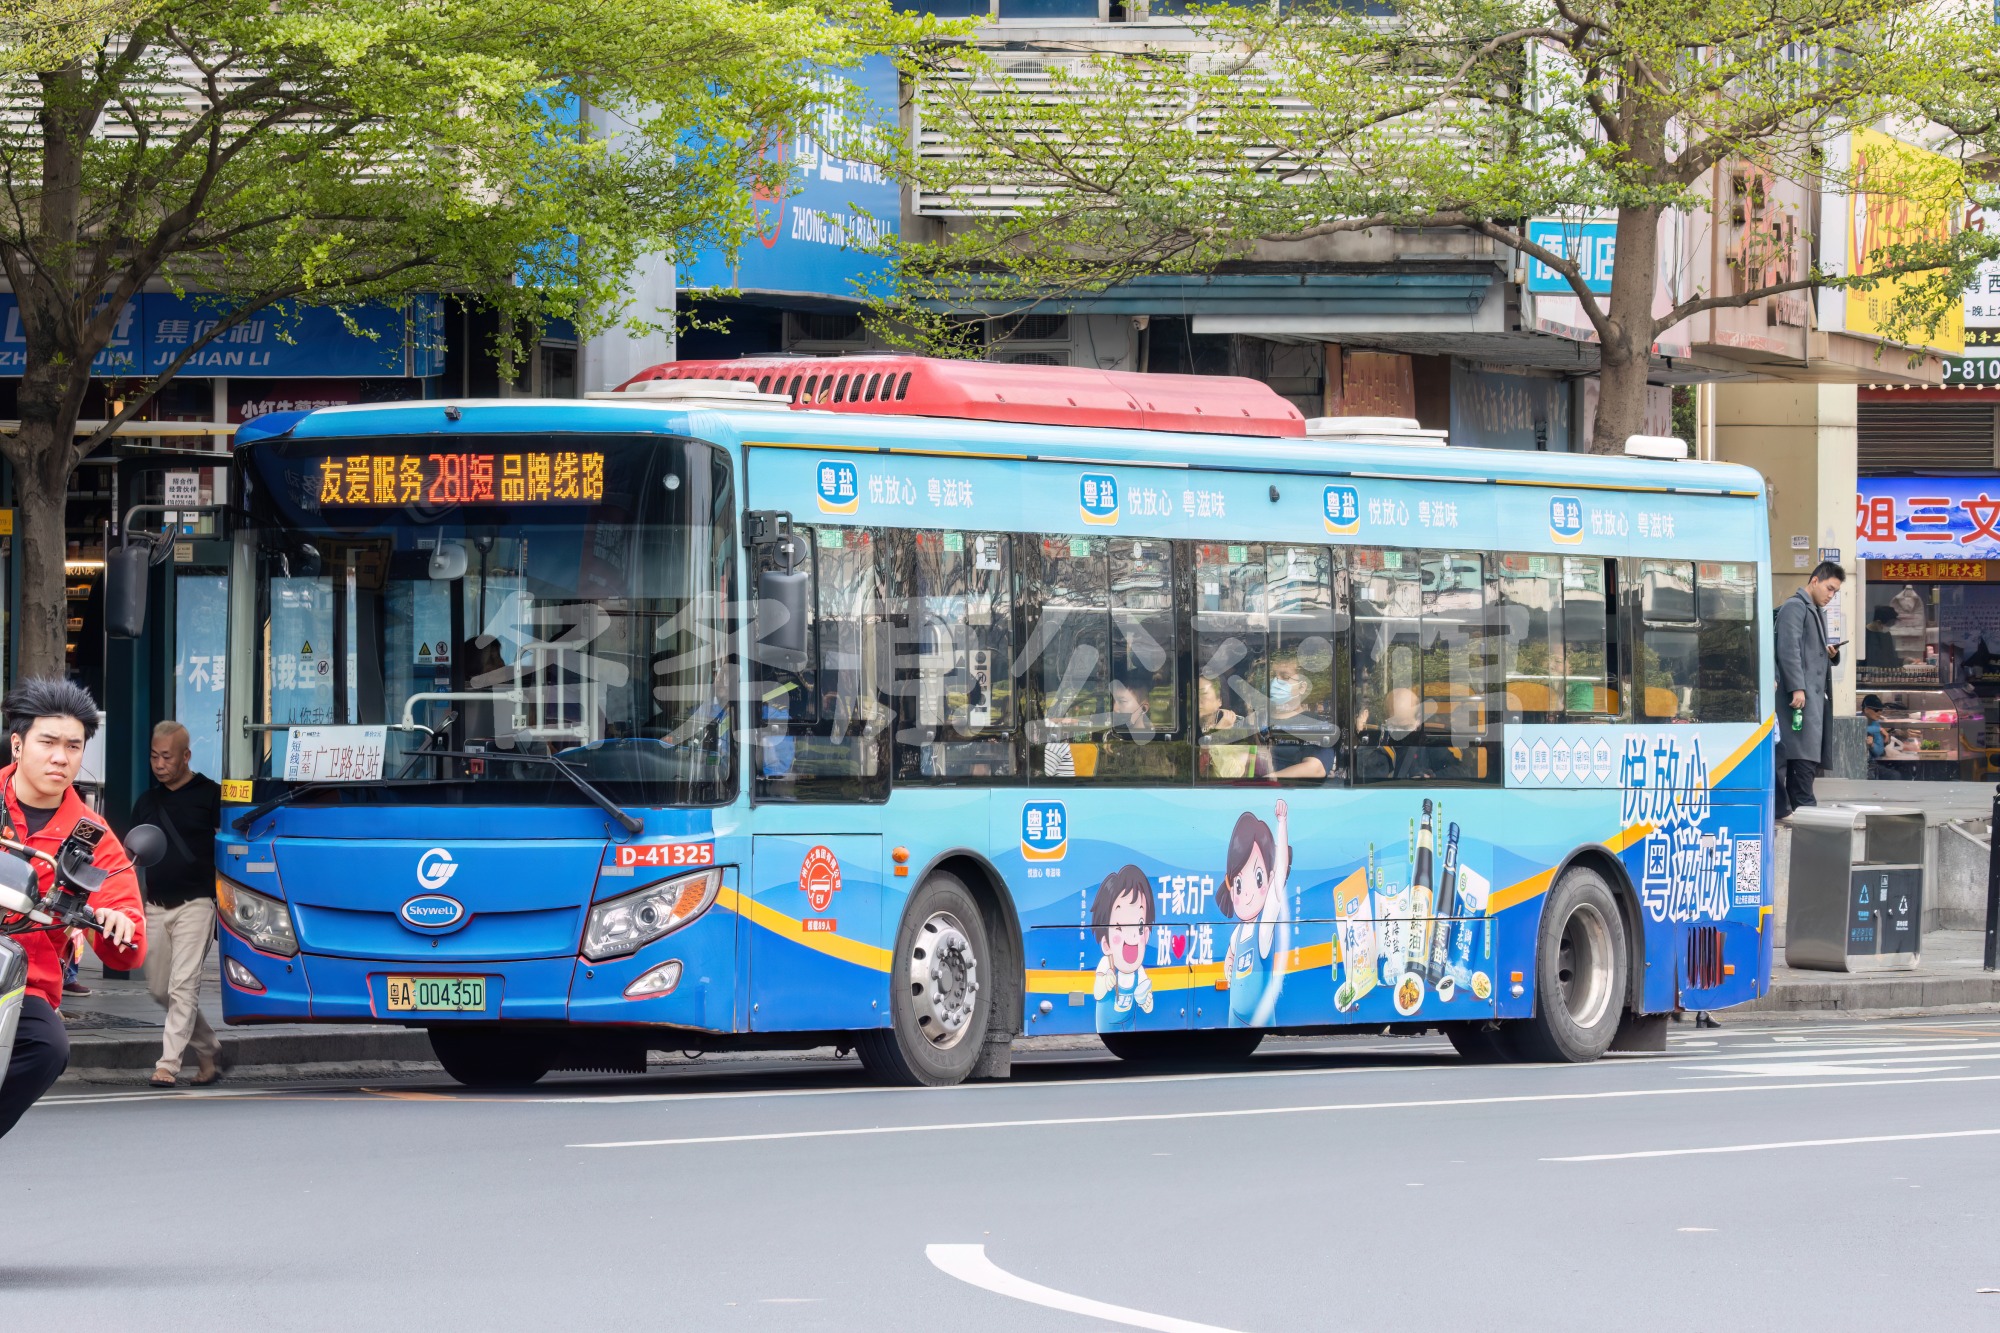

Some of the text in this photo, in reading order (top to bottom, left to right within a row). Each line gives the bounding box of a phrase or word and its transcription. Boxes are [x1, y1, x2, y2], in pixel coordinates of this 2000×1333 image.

[791, 206, 827, 244] ZHONG
[1536, 233, 1616, 281] 便利店
[248, 352, 271, 366] LI
[821, 467, 974, 509] 粤盐 悦放心 粤滋味
[1083, 480, 1226, 518] 粤盐 悦放心 粤滋味
[1326, 490, 1459, 528] 粤盐 悦放心 粤滋味
[1552, 502, 1675, 539] 粤盐 悦放心 粤滋味
[1857, 493, 2000, 544] 姐三文
[311, 745, 380, 781] 广卫路总站
[1617, 732, 1711, 828] 悦放心
[1026, 808, 1063, 840] 粤盐
[622, 845, 711, 865] D-41325
[1642, 827, 1732, 923] 粤滋味
[409, 906, 455, 916] Skywell
[816, 894, 825, 905] EV
[1158, 875, 1214, 915] 千家万户
